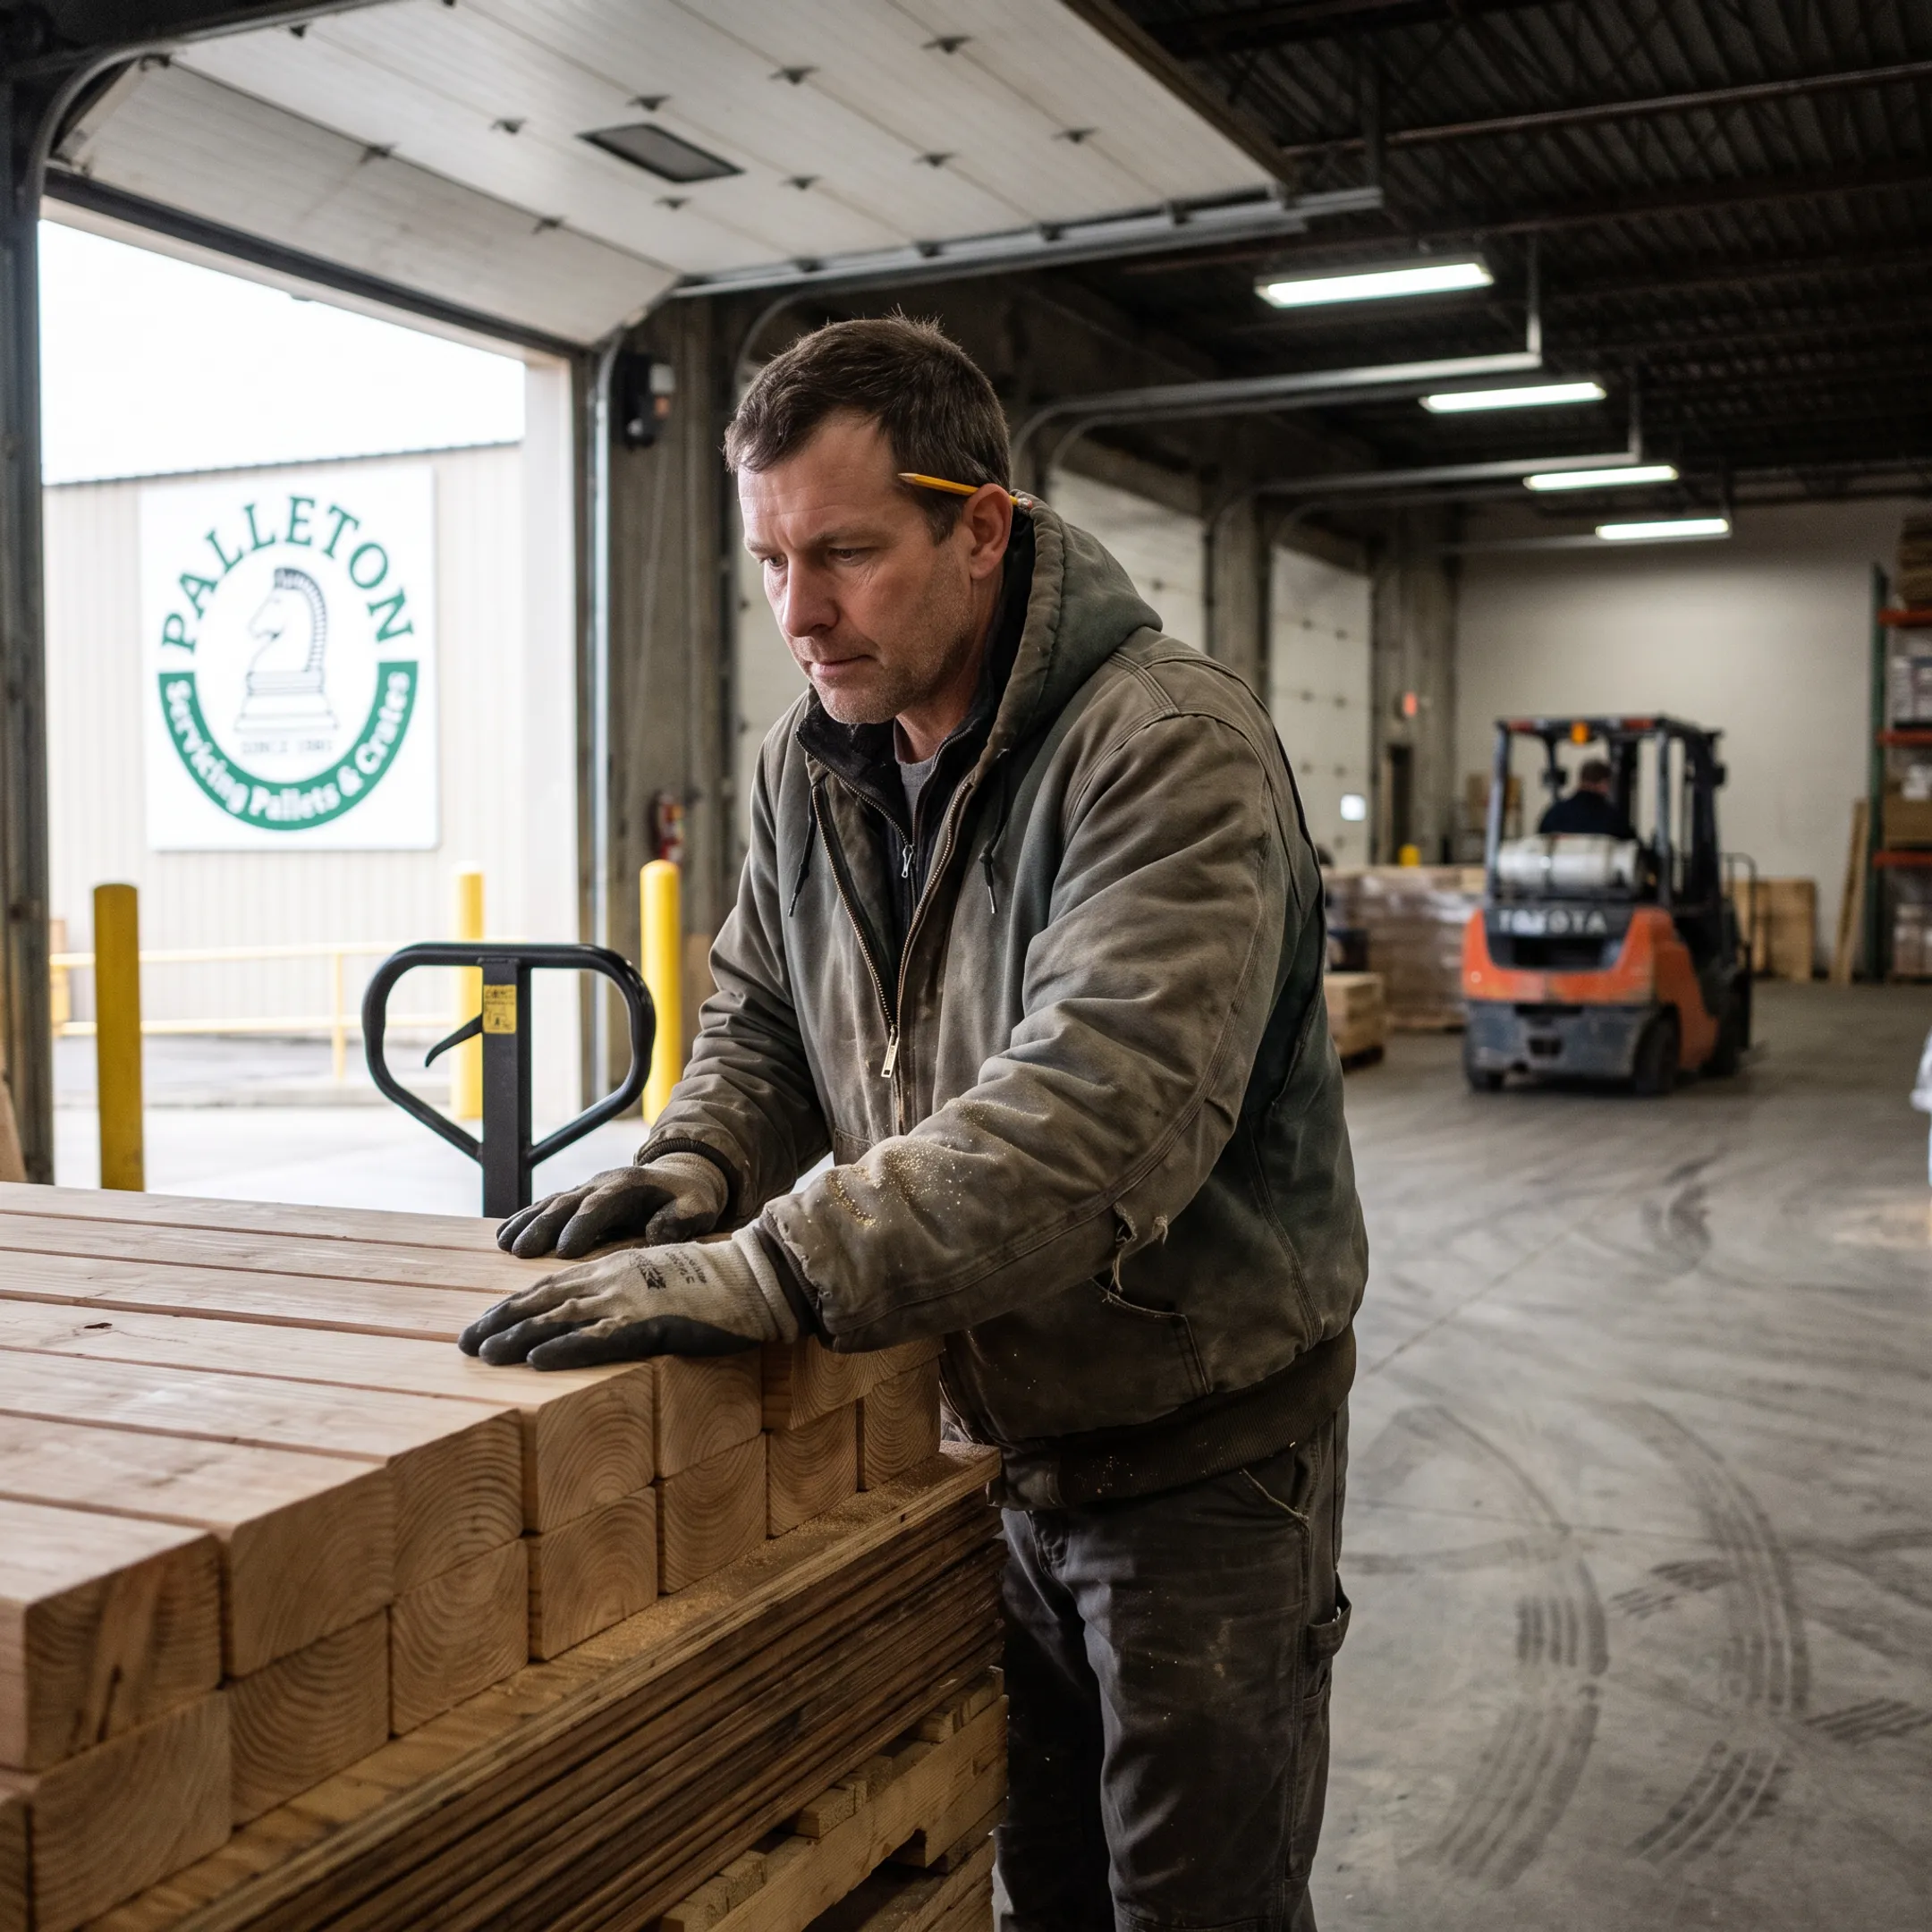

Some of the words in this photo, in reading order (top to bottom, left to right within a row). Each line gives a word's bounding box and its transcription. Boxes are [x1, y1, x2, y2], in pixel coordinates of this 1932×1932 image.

[162, 496, 414, 654] PALLETON
[166, 680, 249, 814] Servicing
[249, 784, 340, 821] Pallets
[337, 766, 364, 797] &
[355, 672, 410, 775] Crates
